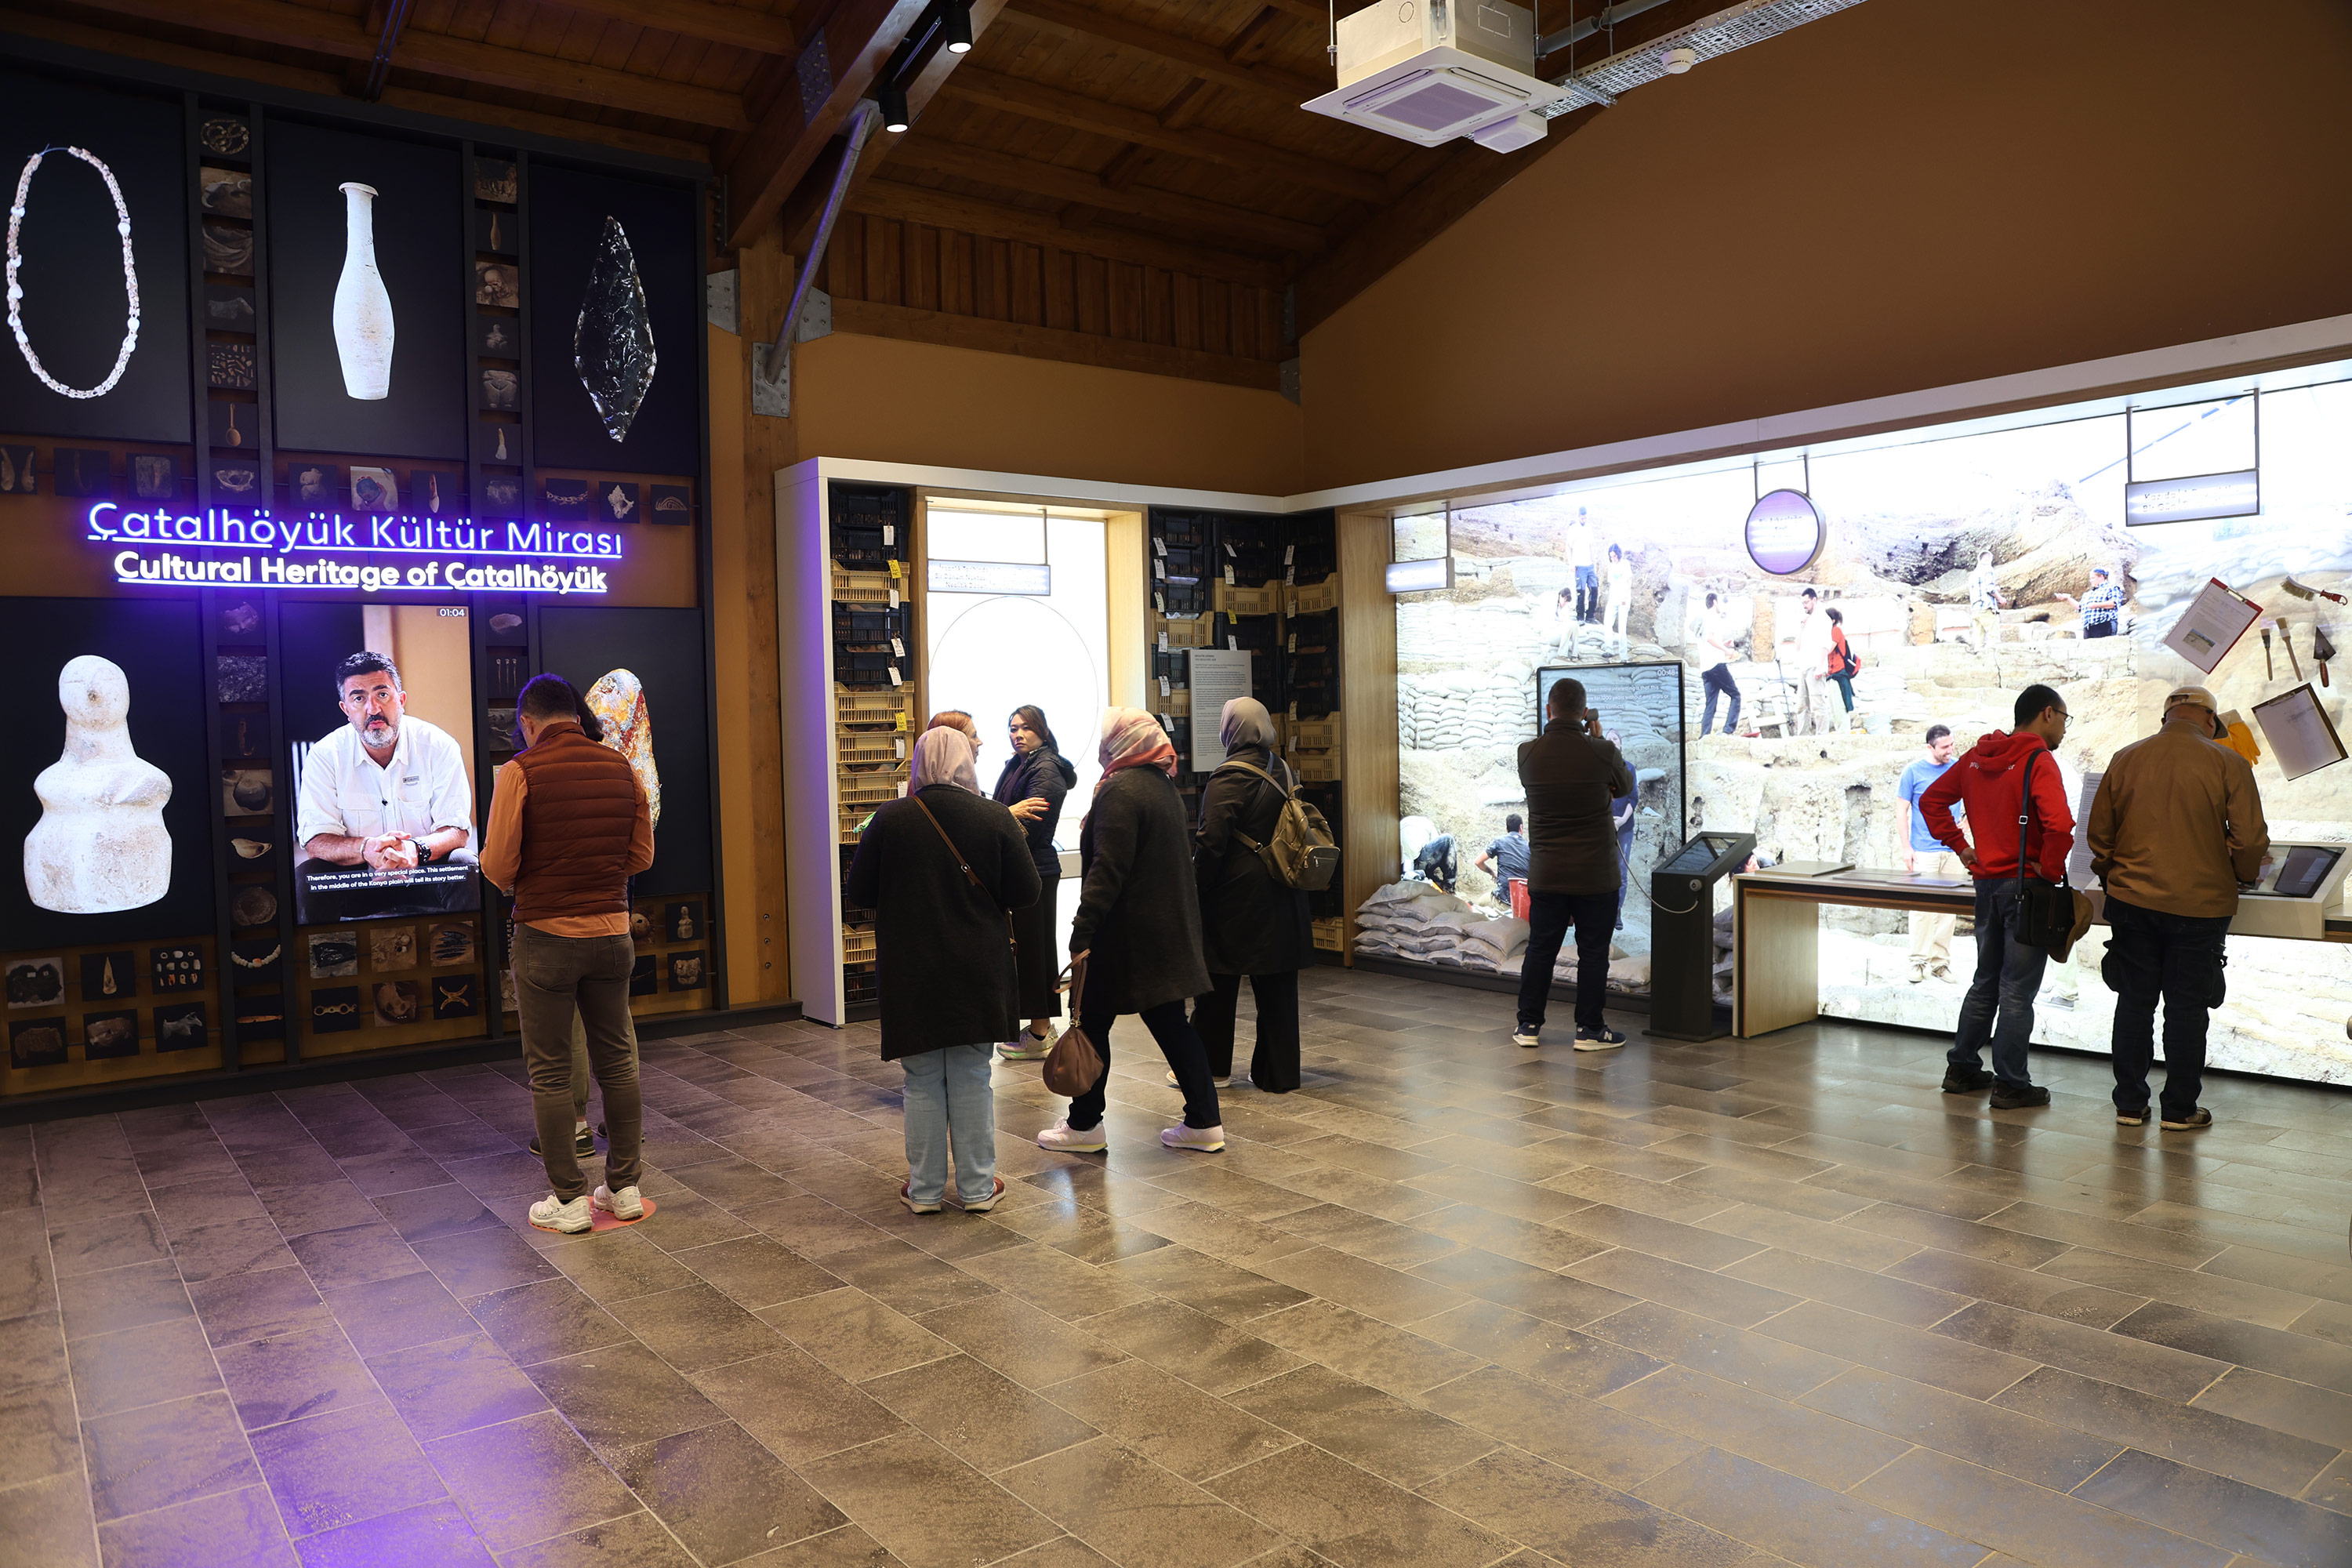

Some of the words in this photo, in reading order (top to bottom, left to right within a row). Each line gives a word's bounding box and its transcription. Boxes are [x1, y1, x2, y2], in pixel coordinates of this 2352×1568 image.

[88, 502, 355, 554] Çatalhöyük
[371, 515, 494, 549] Kültür
[507, 521, 622, 554] Mirası
[114, 550, 252, 583] Cultural
[260, 557, 400, 592] Heritage
[406, 561, 439, 586] of
[445, 561, 608, 594] Çatalhöyük
[439, 608, 465, 617] 01:04
